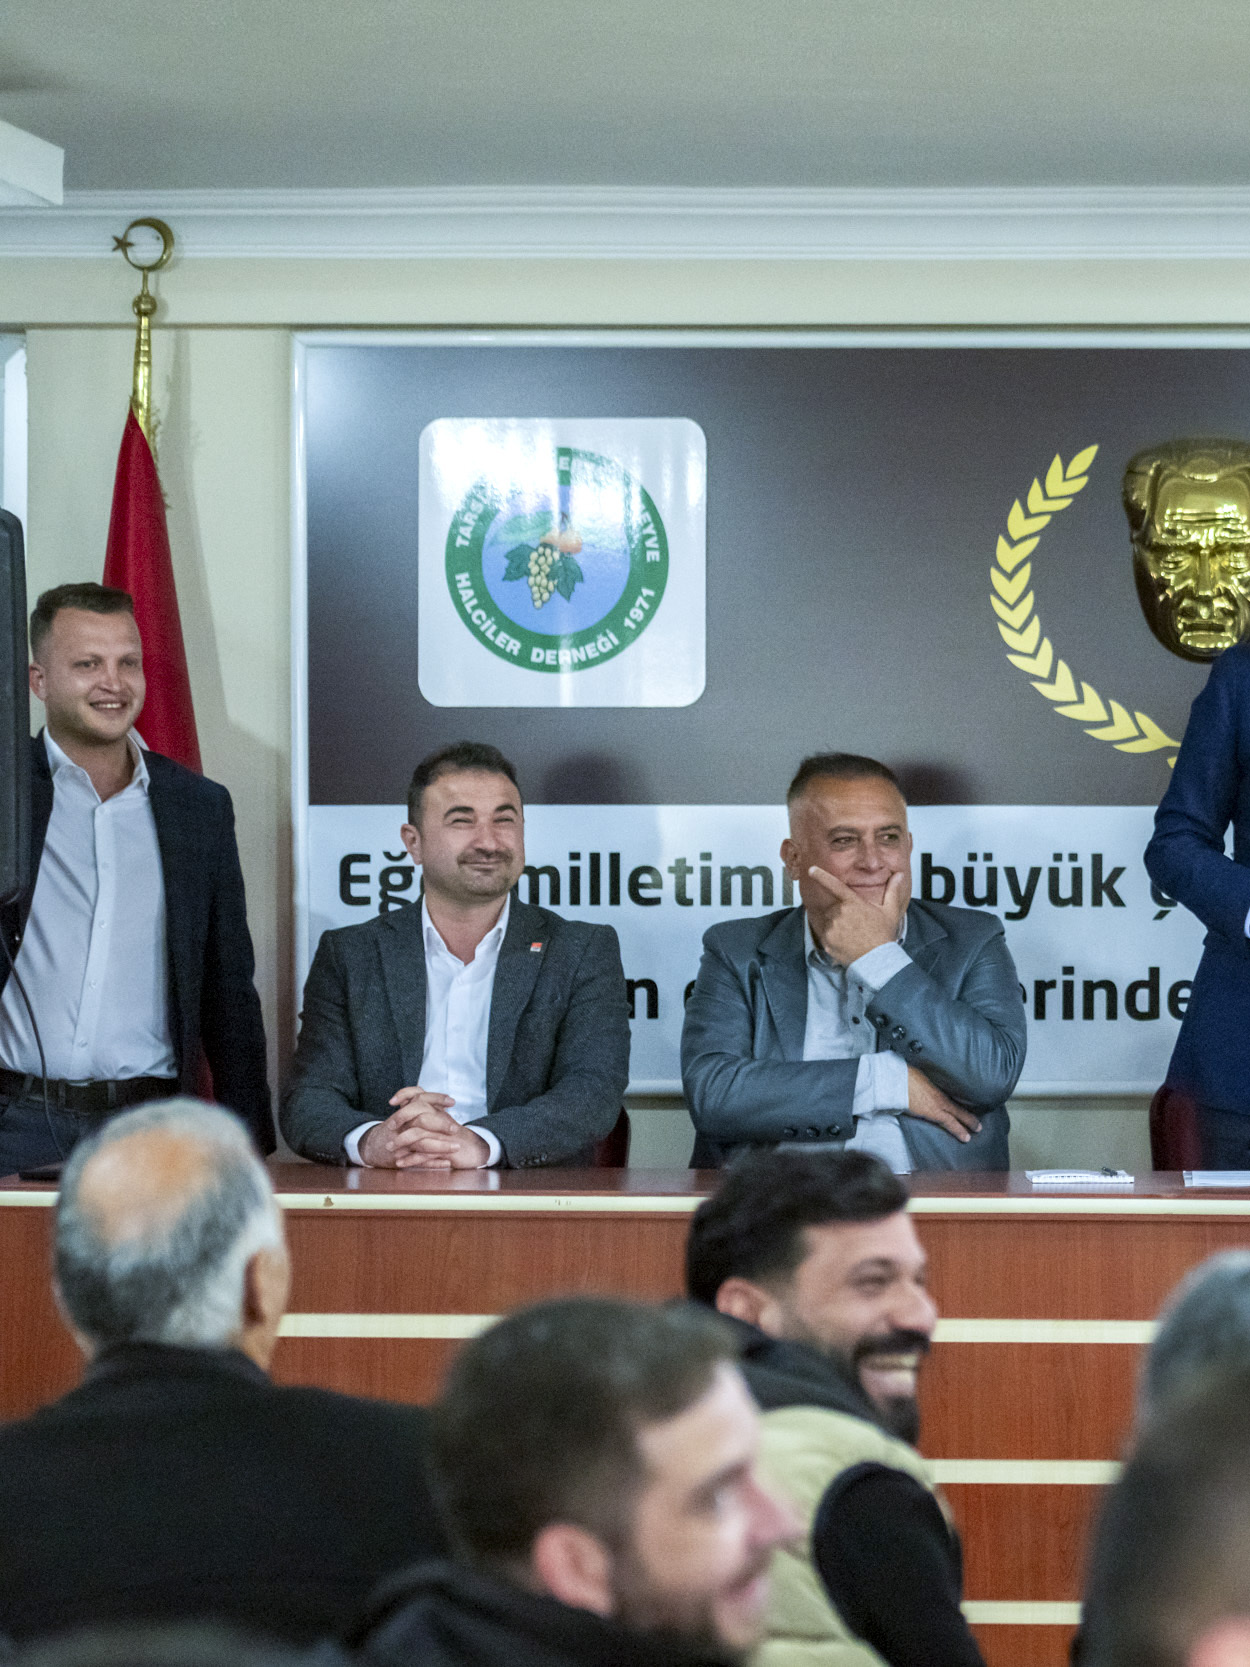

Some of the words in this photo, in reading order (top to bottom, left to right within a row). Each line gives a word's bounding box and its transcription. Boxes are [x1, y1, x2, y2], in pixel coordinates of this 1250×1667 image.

[455, 492, 490, 548] TARS
[640, 505, 660, 563] EYVE
[530, 628, 620, 665] DERNEĞİ
[623, 587, 656, 630] 1971
[514, 852, 794, 906] milletimi
[920, 852, 1126, 921] büyük
